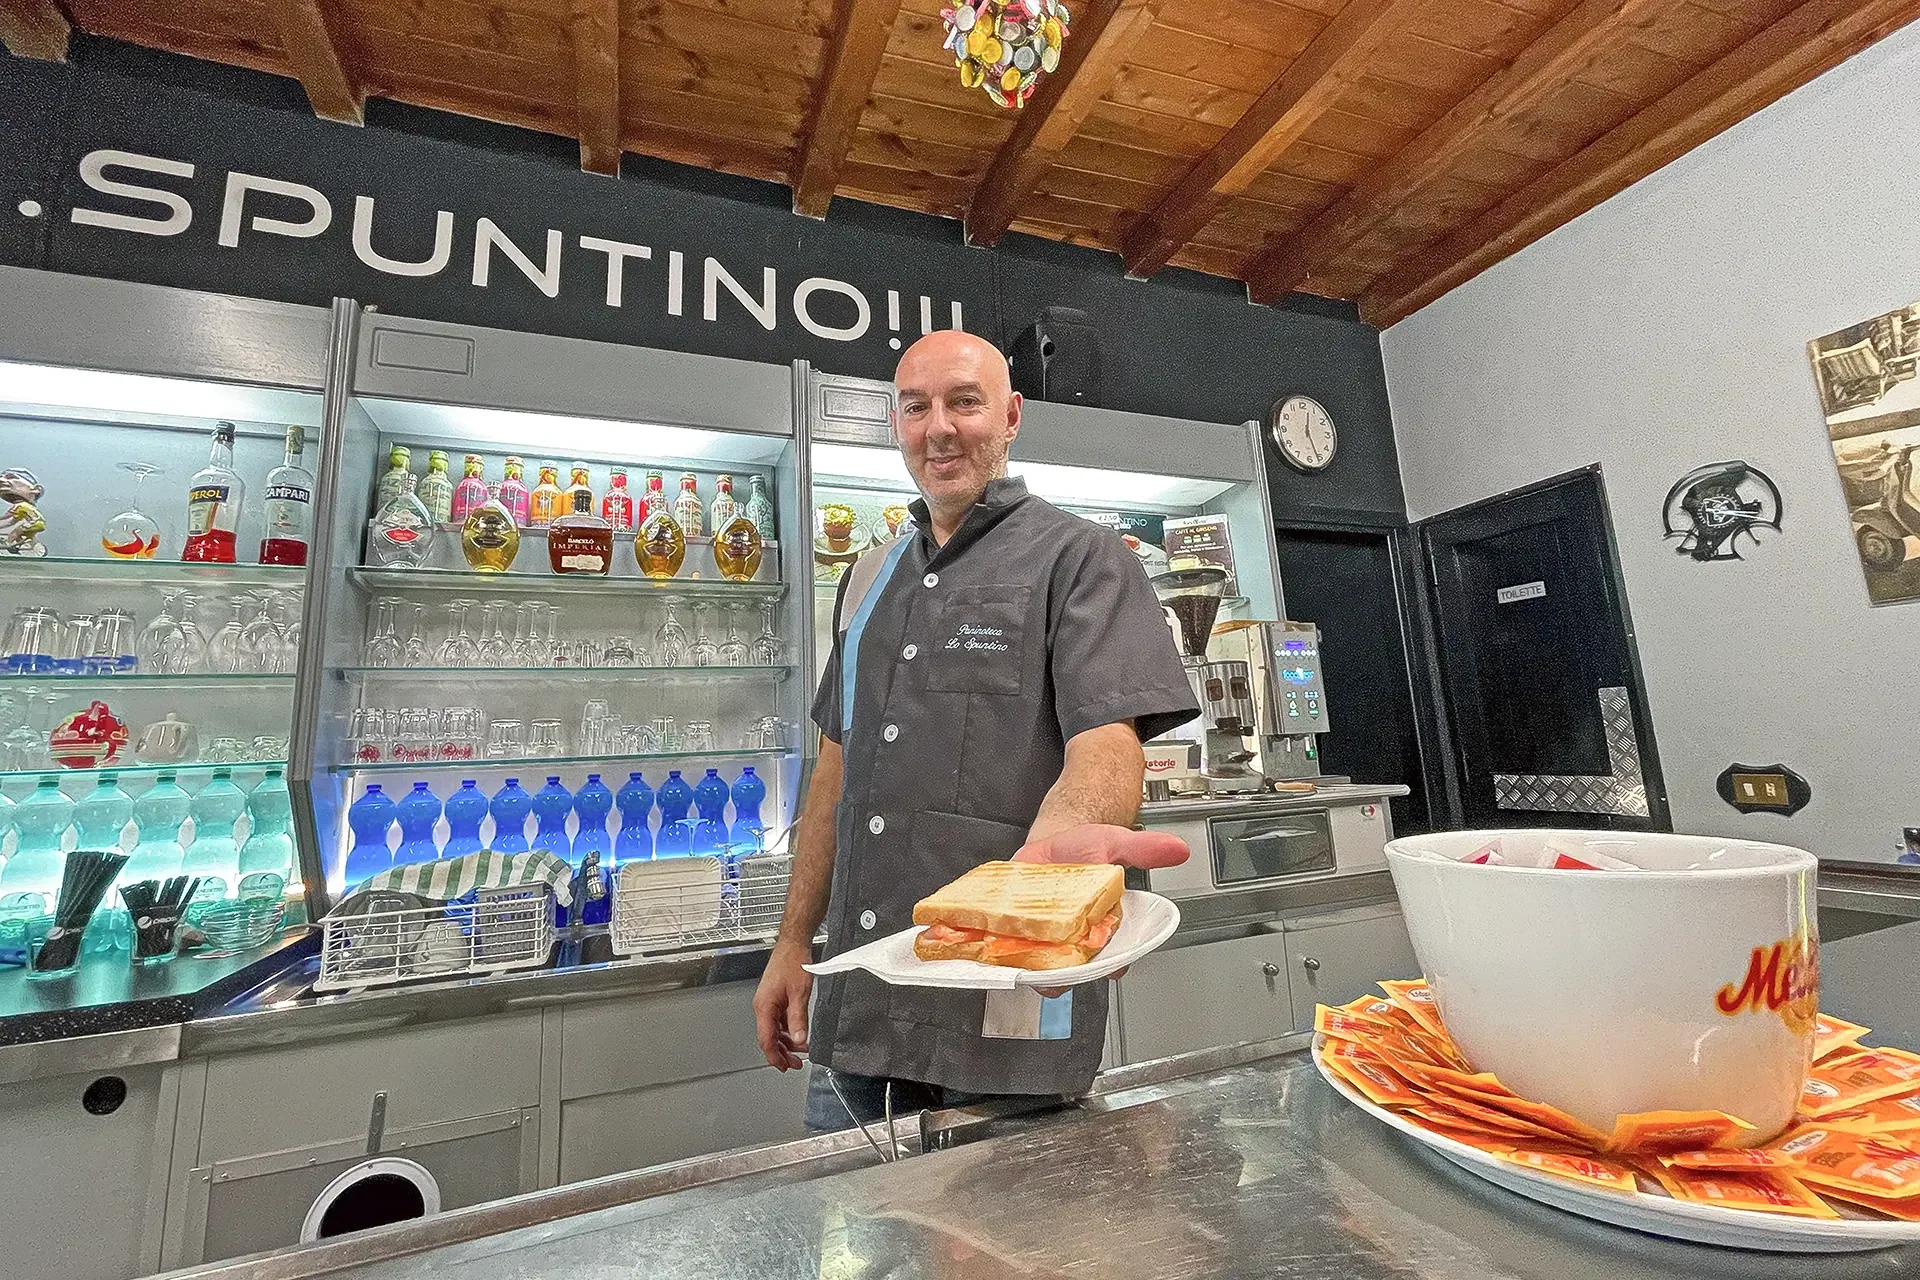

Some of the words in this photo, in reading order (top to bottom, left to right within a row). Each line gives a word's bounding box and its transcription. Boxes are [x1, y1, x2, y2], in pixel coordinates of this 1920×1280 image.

[1290, 404, 1296, 412] 11
[1298, 402, 1306, 410] 12
[1319, 417, 1326, 426] 2
[1281, 425, 1287, 433] 9
[1324, 431, 1331, 439] 3
[1324, 444, 1330, 452] 4
[1295, 450, 1301, 458] 7
[1307, 455, 1313, 463] 6
[553, 543, 609, 551] IMPERIAL
[1500, 584, 1543, 600] TOILETTE
[963, 636, 1009, 652] Spuntino
[1145, 758, 1176, 768] storia
